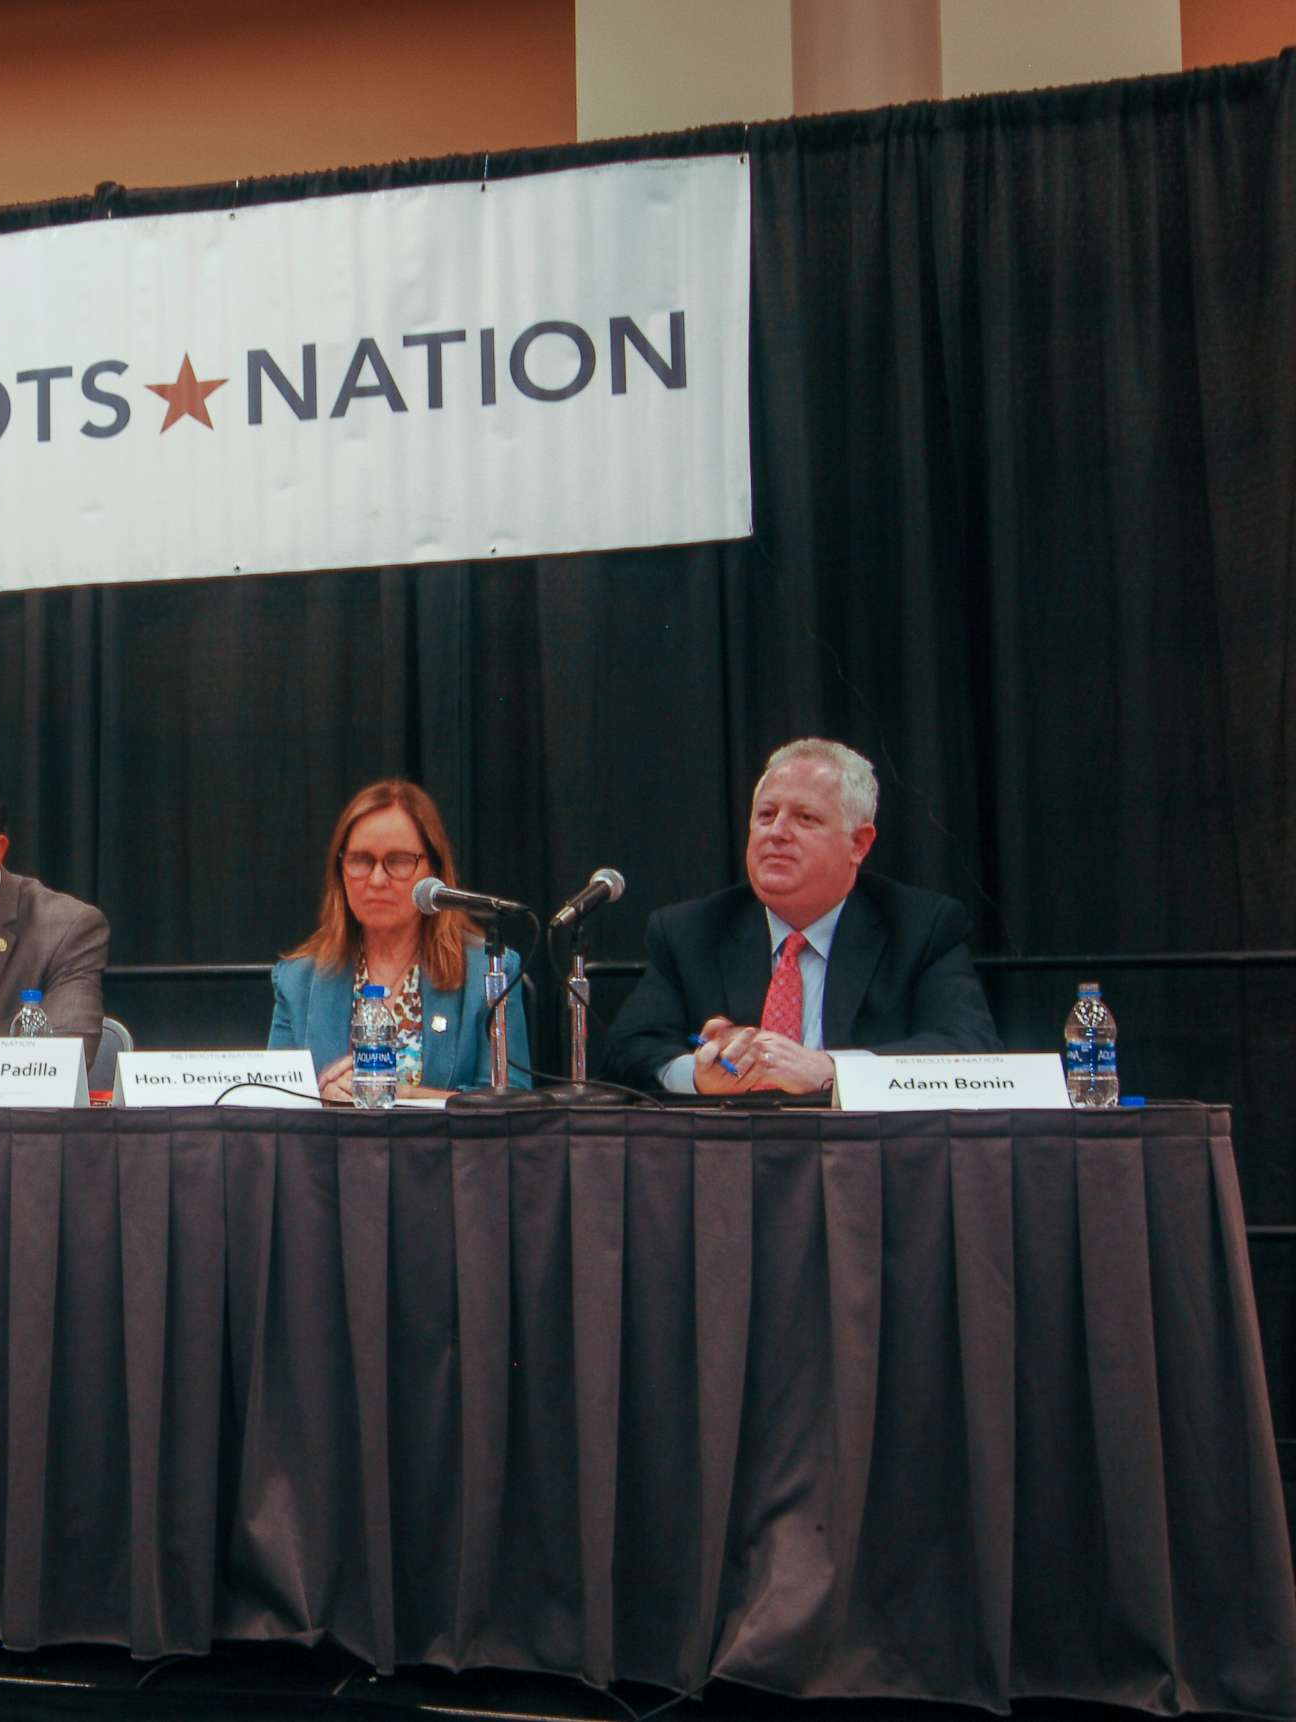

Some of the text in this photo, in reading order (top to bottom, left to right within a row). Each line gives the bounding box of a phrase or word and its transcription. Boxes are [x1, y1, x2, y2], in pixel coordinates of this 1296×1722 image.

[247, 311, 688, 427] NATION
[0, 1063, 57, 1077] Padilla
[135, 1071, 304, 1085] Hon. Denise Merrill
[888, 1076, 1015, 1089] Adam Bonin
